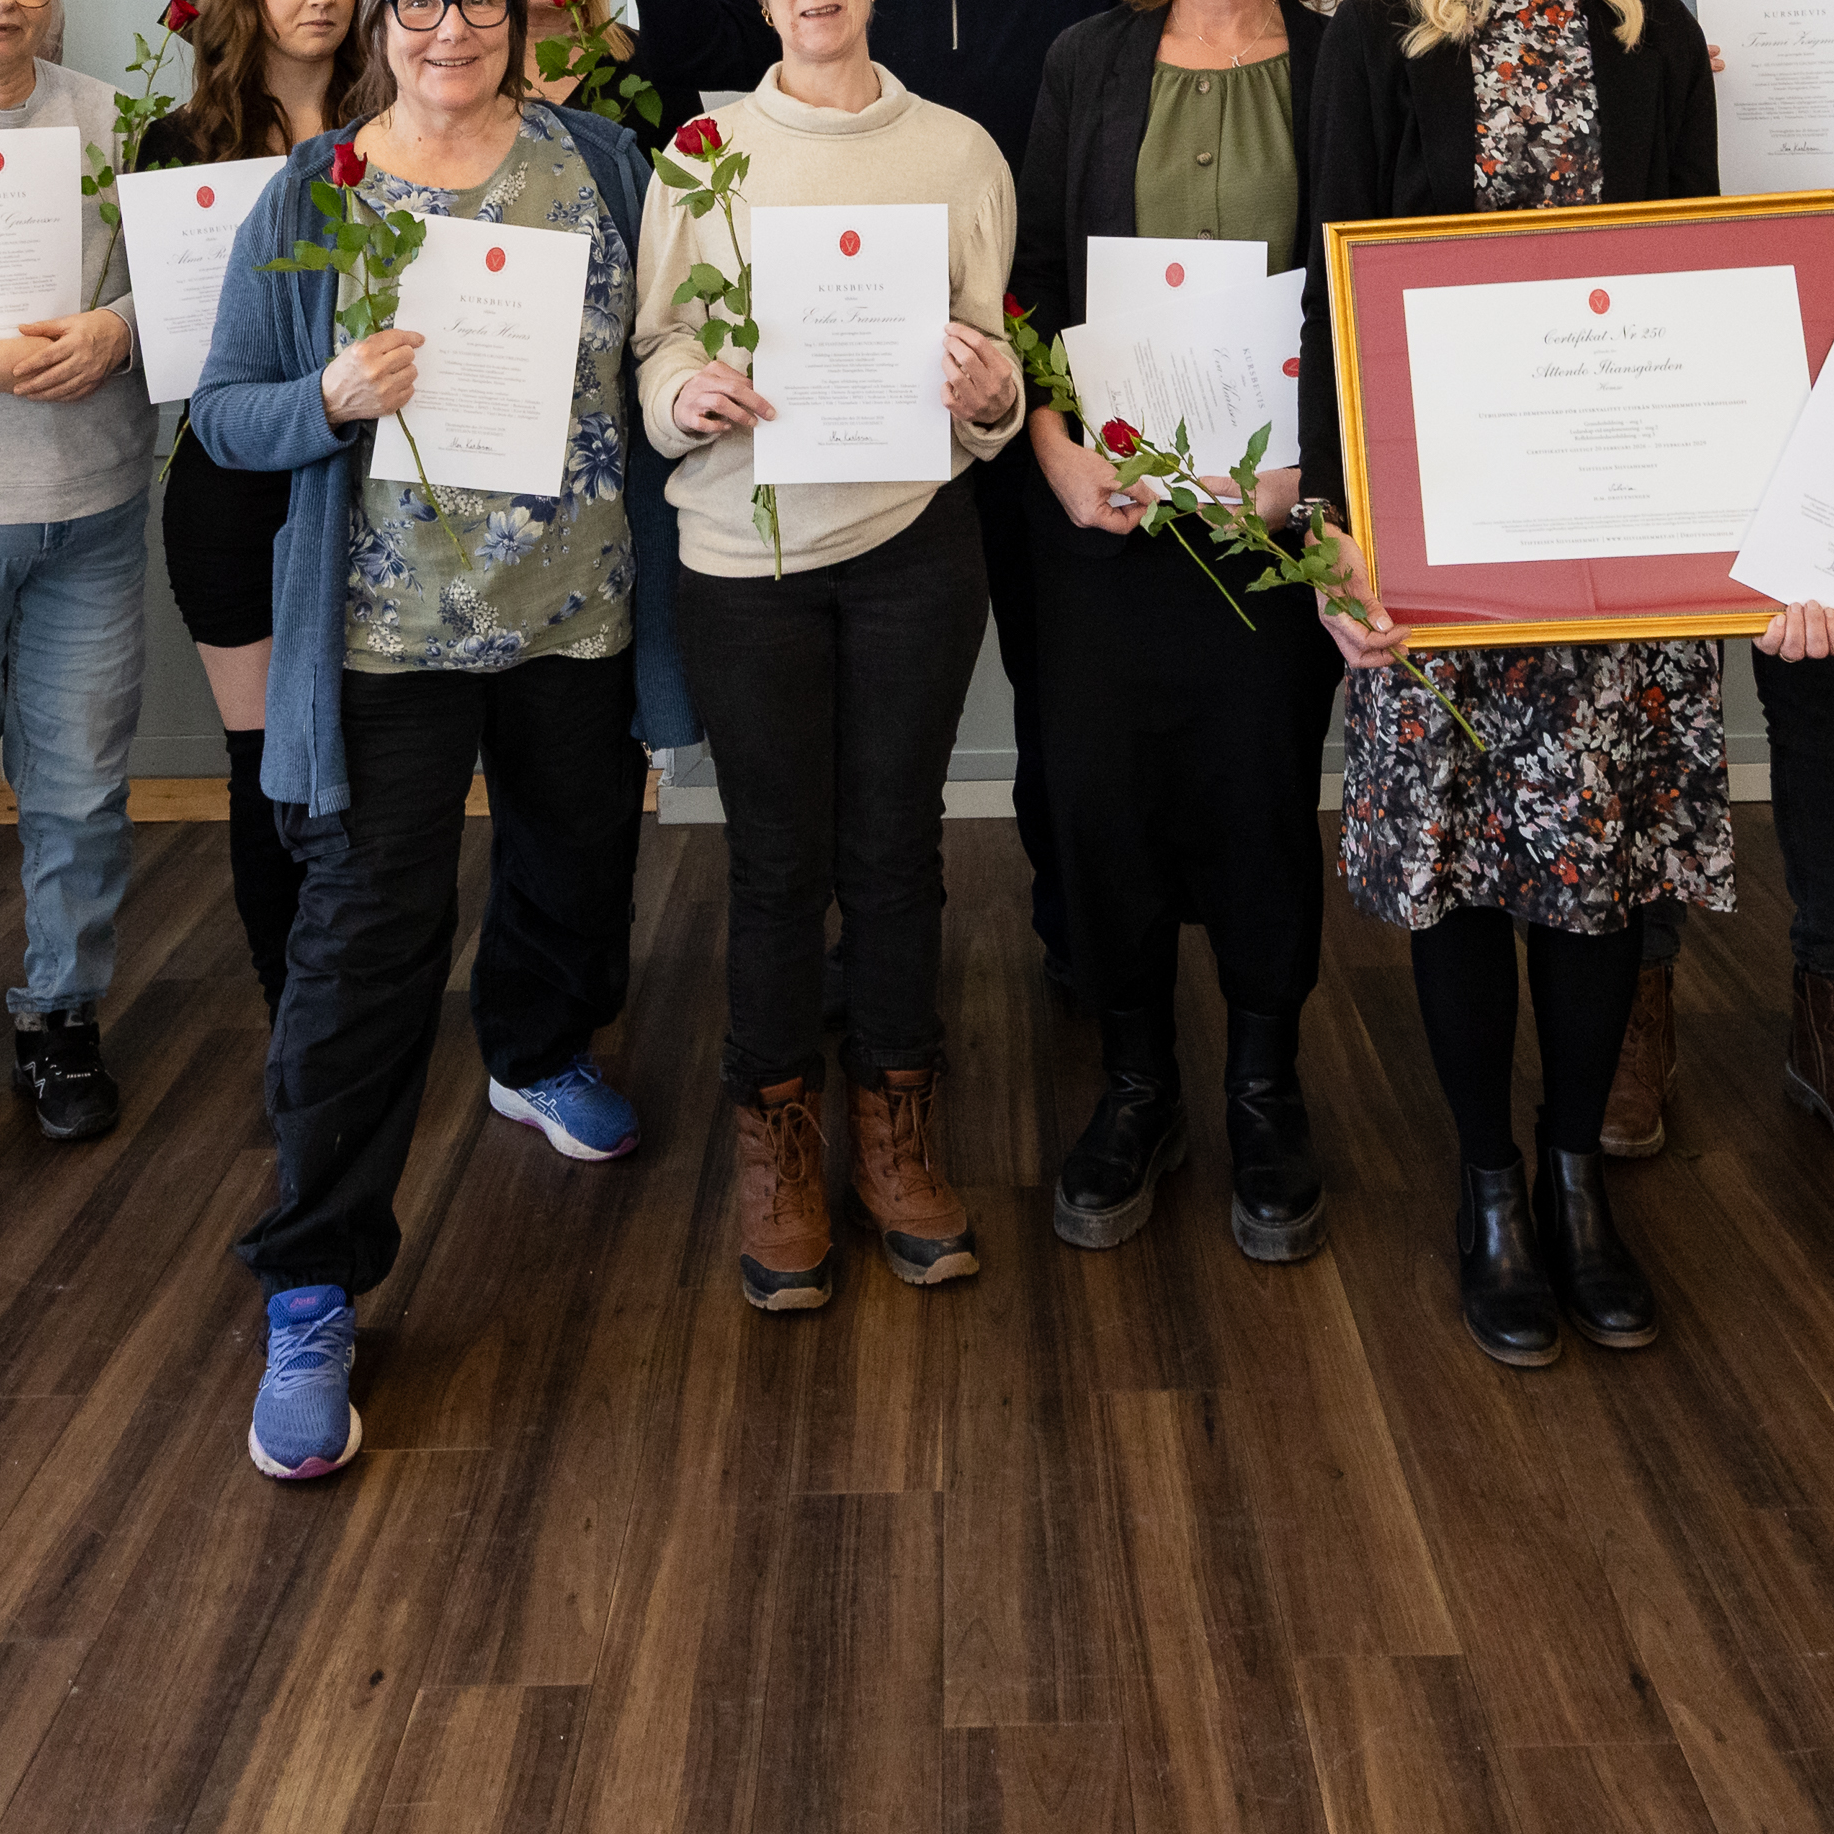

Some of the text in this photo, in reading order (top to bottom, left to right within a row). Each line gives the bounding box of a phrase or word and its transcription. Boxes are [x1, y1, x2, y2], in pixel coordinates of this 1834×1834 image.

[1763, 9, 1828, 20] KURSBEVIS
[1741, 31, 1789, 48] Tommi
[818, 283, 885, 293] KURSBEVIS
[460, 294, 523, 309] KURSBEVIS
[802, 307, 838, 325] Erika
[1544, 324, 1666, 348] Certifikat Nr 250
[1242, 347, 1266, 410] KURSBEVIS
[1531, 361, 1589, 379] Attendo
